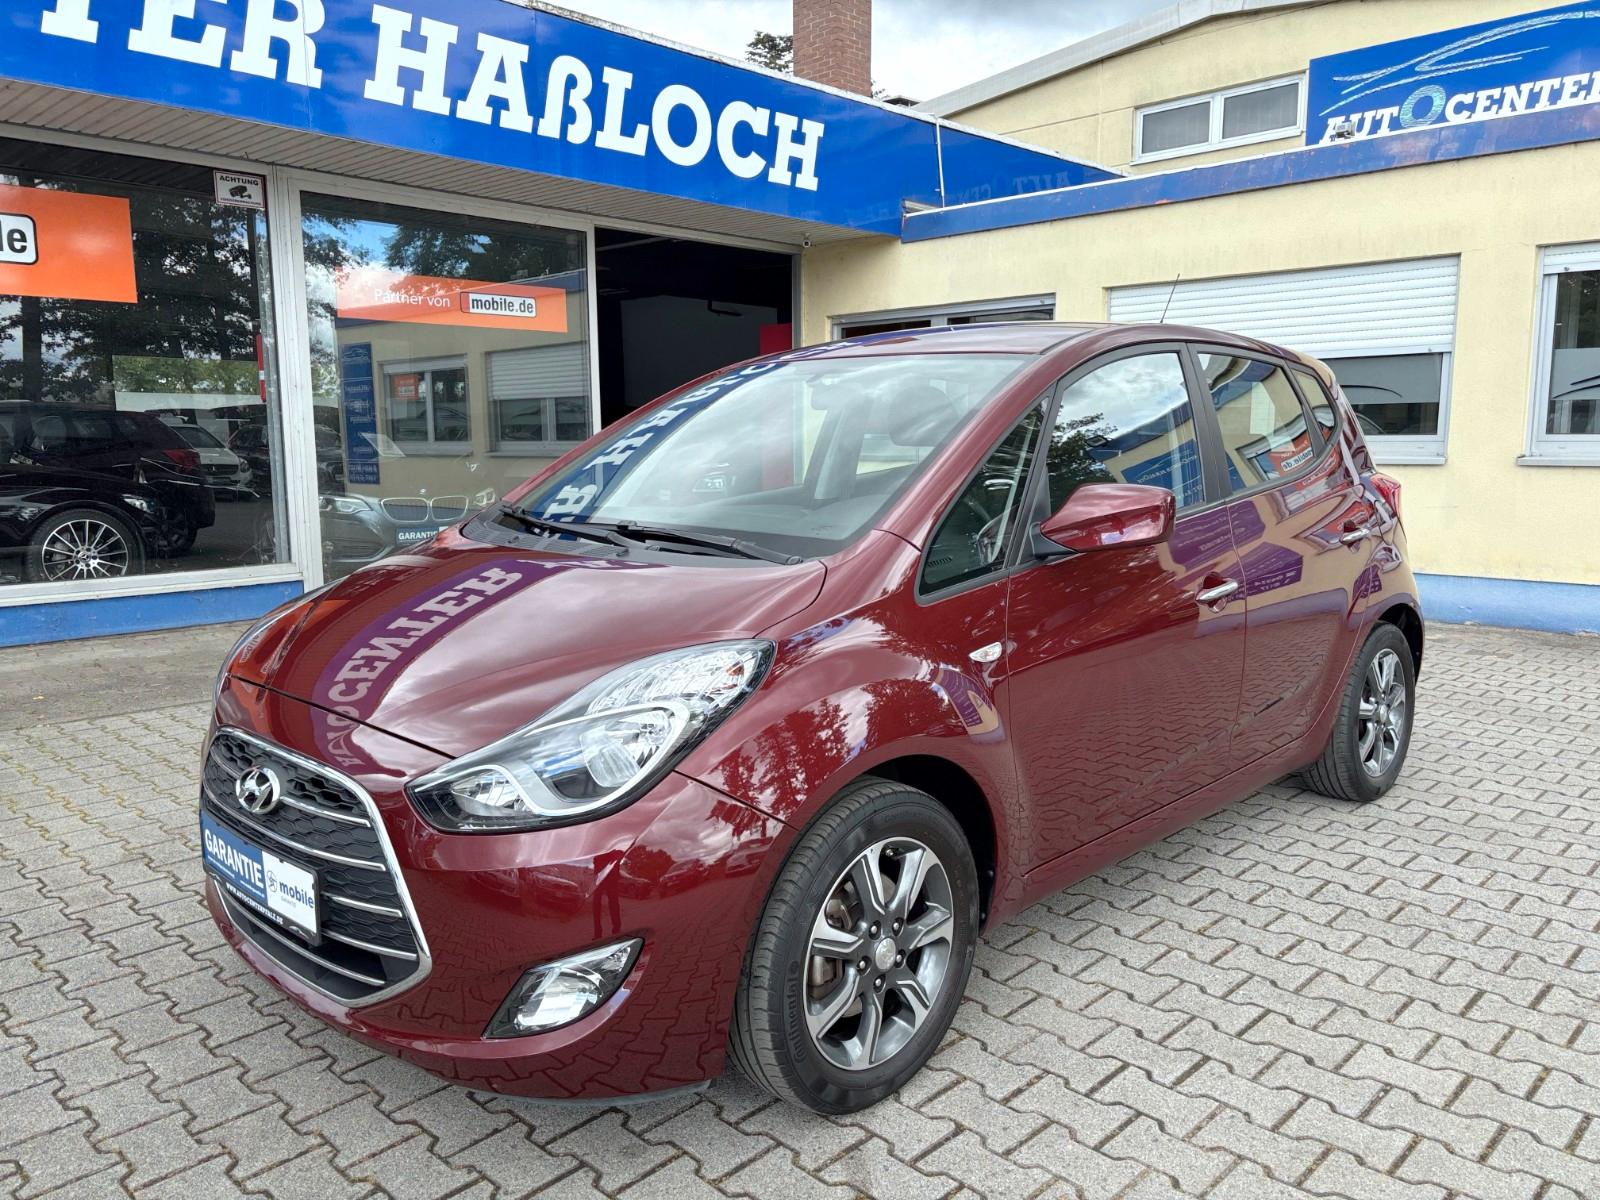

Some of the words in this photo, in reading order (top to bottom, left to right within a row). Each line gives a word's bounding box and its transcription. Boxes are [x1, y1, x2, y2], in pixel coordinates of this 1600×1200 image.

[219, 175, 259, 186] ACHTUNG
[374, 288, 424, 305] Partner
[427, 295, 451, 308] von
[471, 297, 534, 314] mobile.de
[204, 829, 265, 889] GARANTIE
[279, 880, 315, 909] mobile
